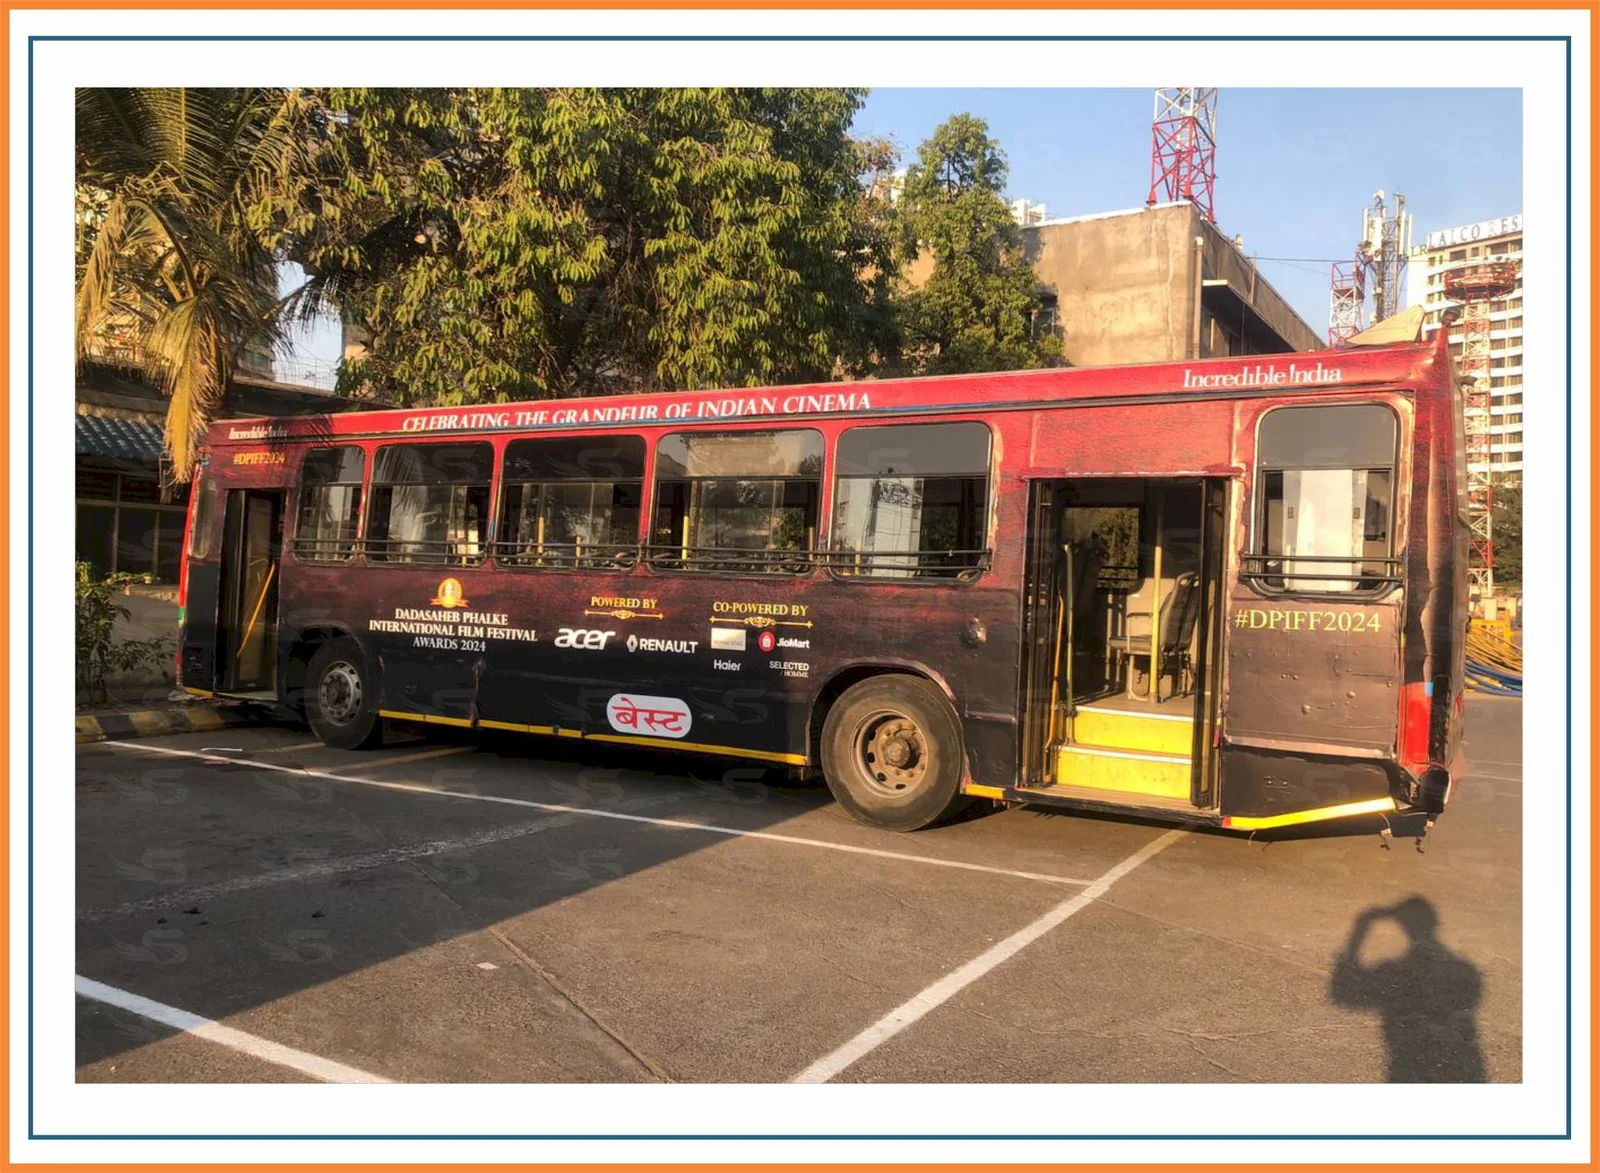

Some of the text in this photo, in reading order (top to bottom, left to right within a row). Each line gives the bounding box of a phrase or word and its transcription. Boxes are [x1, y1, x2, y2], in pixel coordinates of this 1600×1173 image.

[1183, 364, 1286, 389] Incredible
[402, 393, 871, 431] CELEBRATING THE GRANDEUR OF INDIAN CINEMA
[590, 596, 658, 610] POWERED BY
[712, 601, 809, 617] CO-POWERED BY
[395, 609, 509, 626] DADASAHEB PHALKE
[1235, 609, 1381, 632] #DPIFF2024
[369, 620, 539, 642] INTERNATIONAL FILM FESTIVAL
[554, 628, 616, 650] acer
[413, 637, 487, 652] AWARDS 2024
[639, 638, 699, 654] RENAULT
[776, 637, 811, 650] JioMart
[713, 659, 742, 672] Haier
[769, 660, 810, 672] SELECTED
[611, 697, 686, 731] बेस्ट
